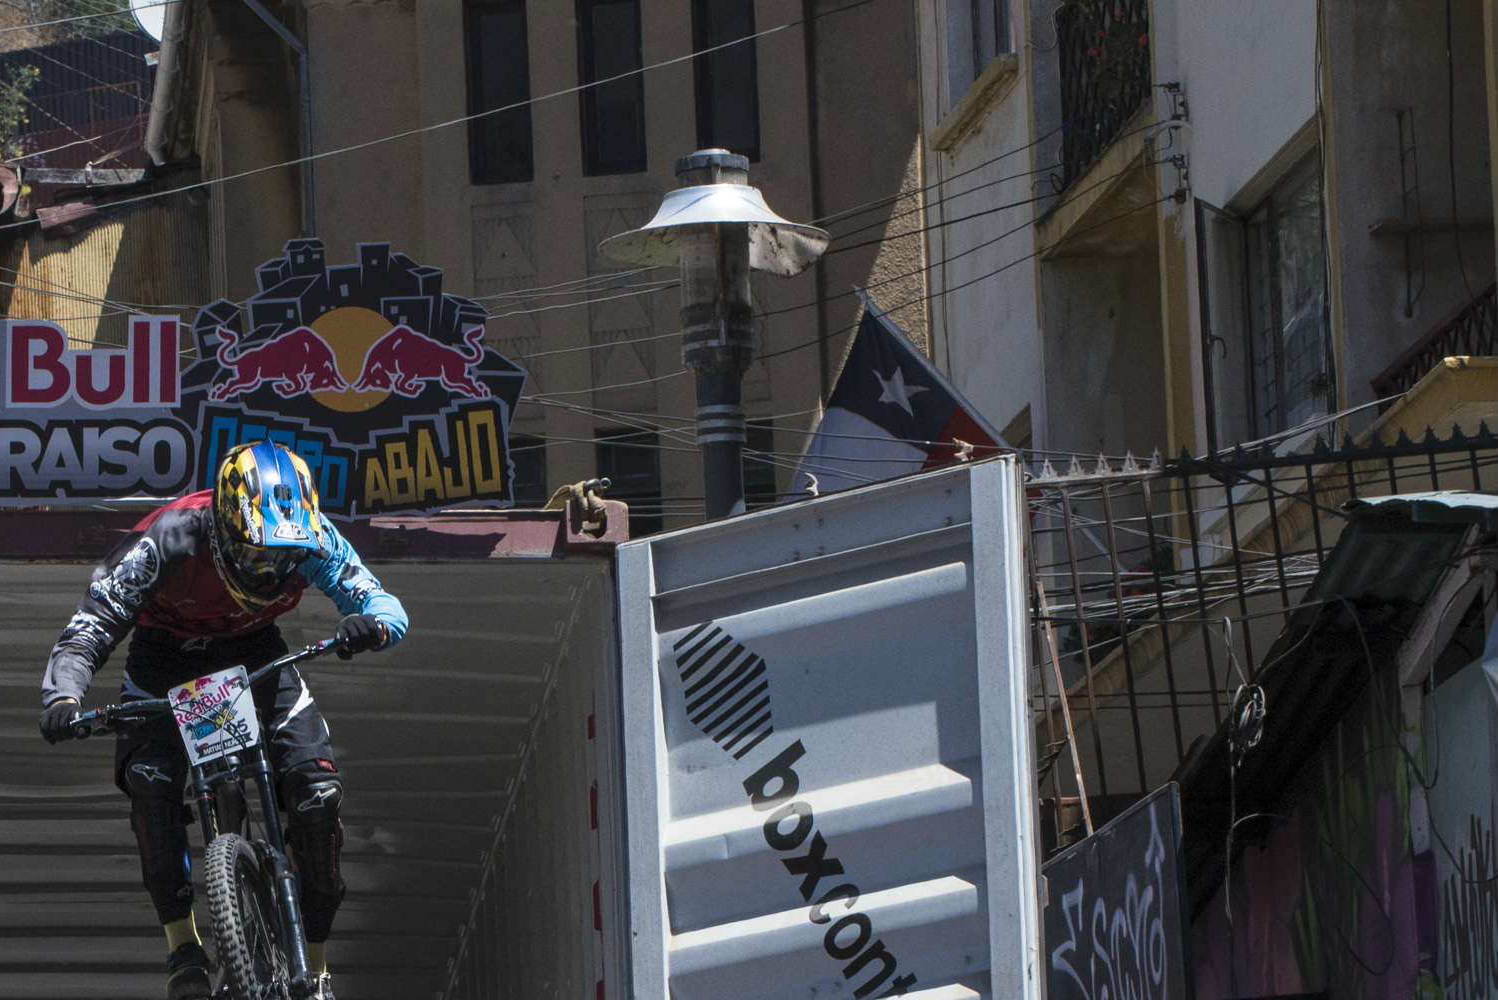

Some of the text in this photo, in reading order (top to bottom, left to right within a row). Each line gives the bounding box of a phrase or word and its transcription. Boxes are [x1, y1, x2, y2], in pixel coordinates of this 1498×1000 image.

[10, 319, 178, 404] Bull
[365, 410, 501, 508] ABAJO
[201, 683, 231, 710] Bull
